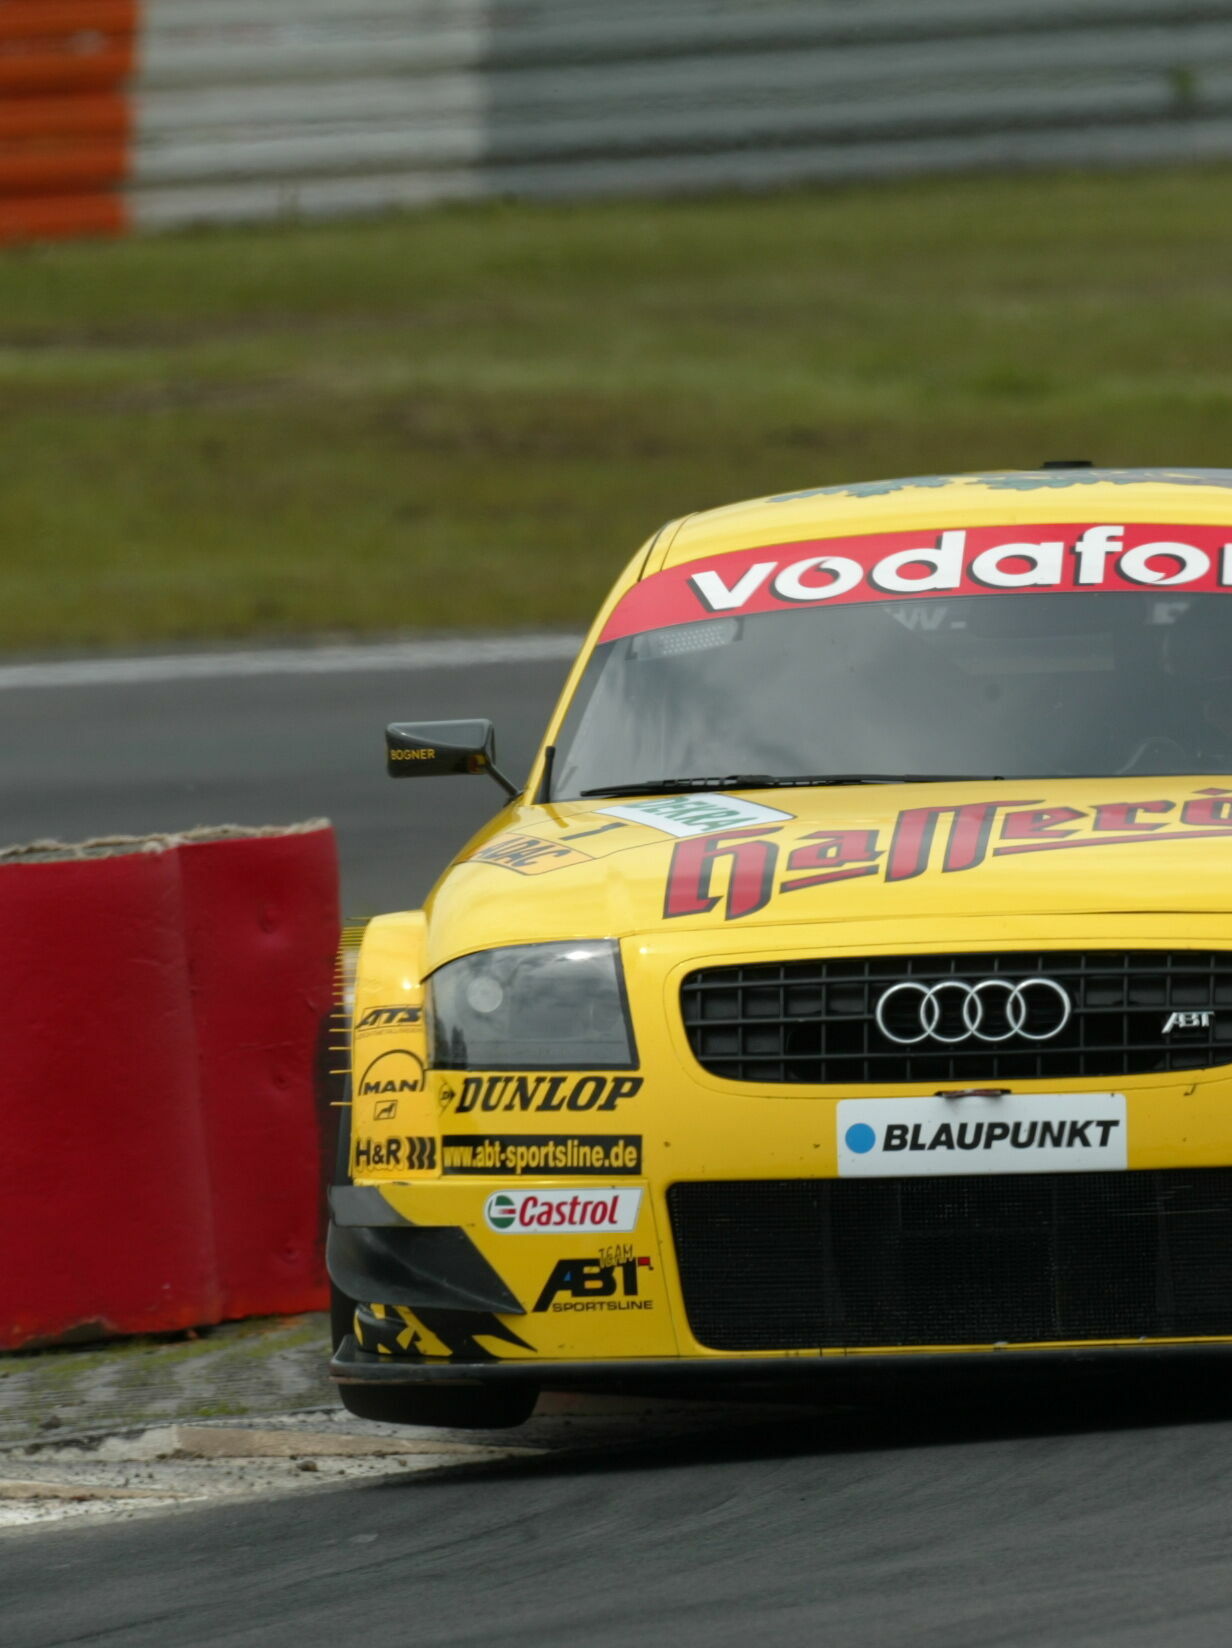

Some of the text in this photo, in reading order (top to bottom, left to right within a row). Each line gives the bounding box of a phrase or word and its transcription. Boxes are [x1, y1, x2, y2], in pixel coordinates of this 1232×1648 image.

[390, 748, 436, 761] BOGNER
[354, 1006, 424, 1030] ATS
[1161, 1010, 1215, 1034] ABT
[363, 1079, 420, 1097] MAN
[455, 1075, 645, 1114] DUNLOP
[882, 1119, 1121, 1152] BLAUPUNKT
[356, 1137, 402, 1168] H&R
[442, 1139, 637, 1175] www.abt-sportsline.de
[518, 1195, 620, 1228] Castrol
[532, 1256, 651, 1313] ABT
[551, 1300, 654, 1313] SPORTSLINE
